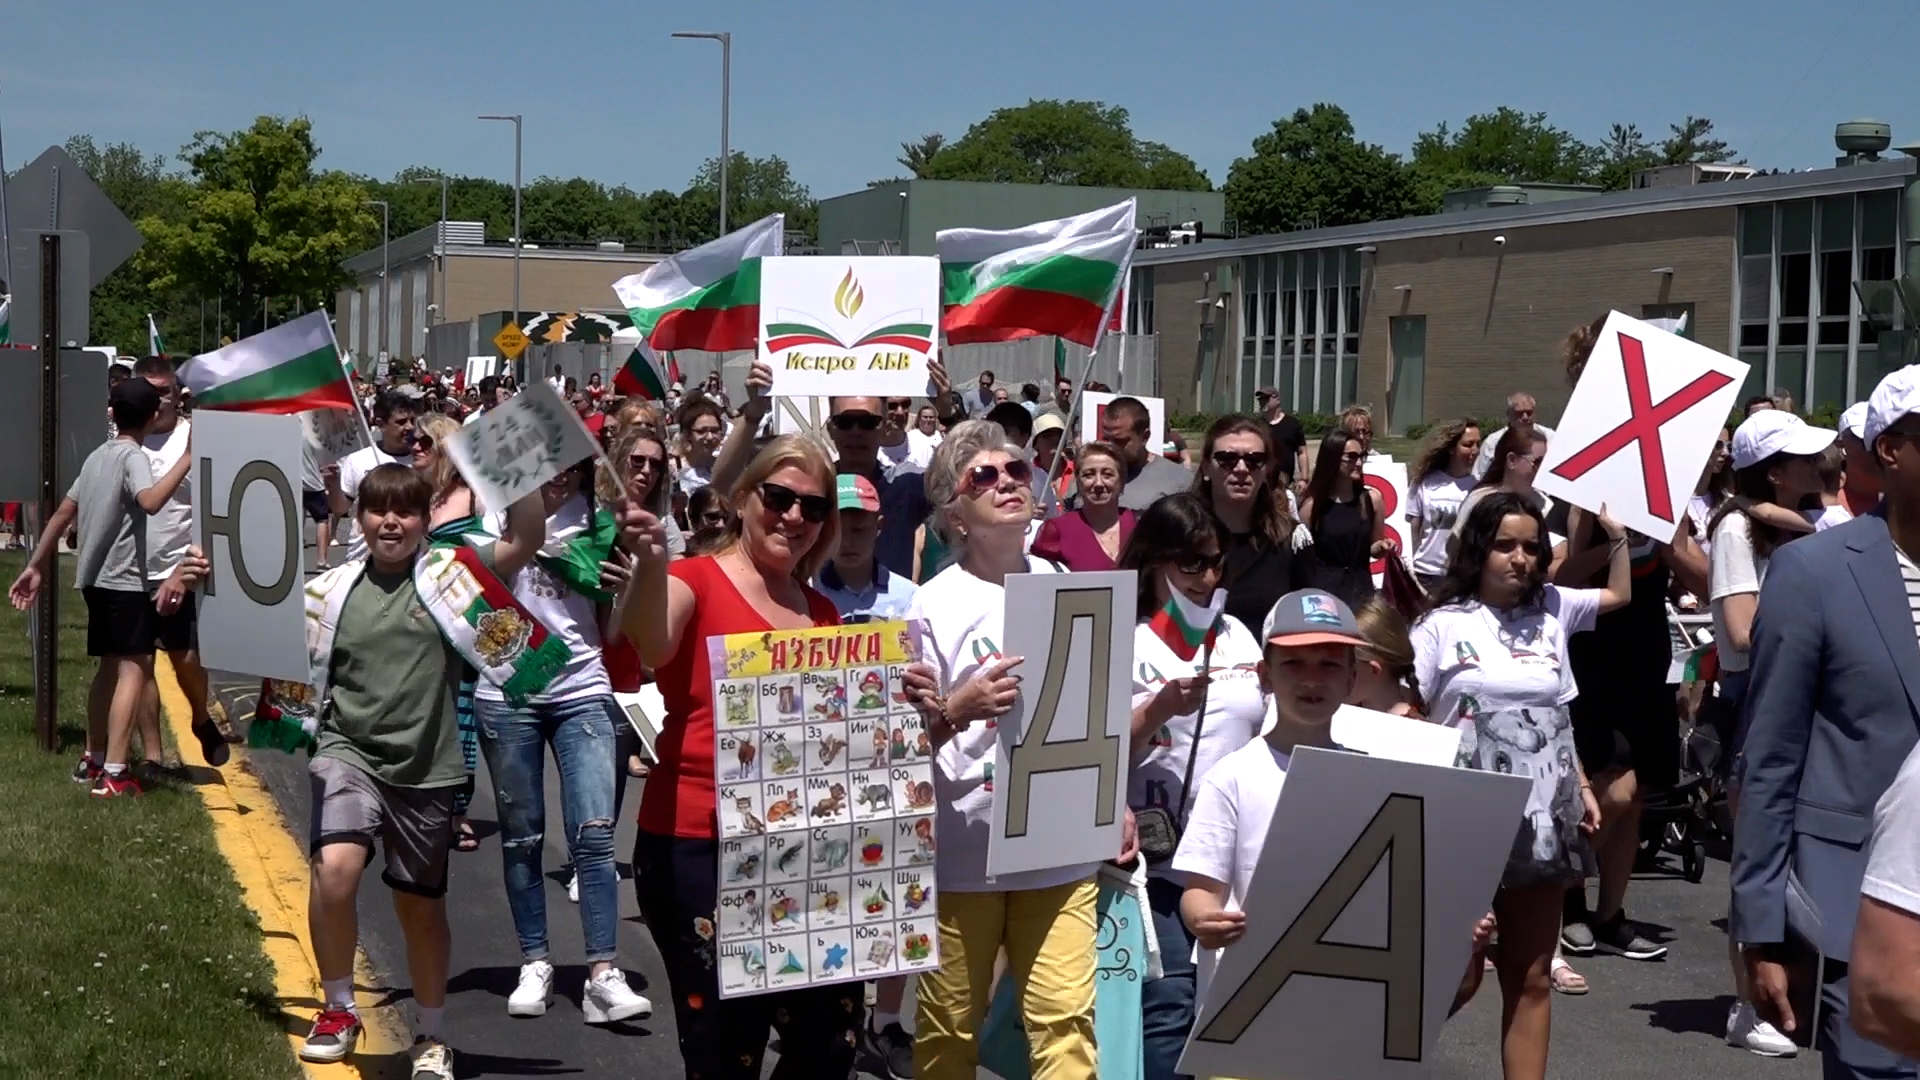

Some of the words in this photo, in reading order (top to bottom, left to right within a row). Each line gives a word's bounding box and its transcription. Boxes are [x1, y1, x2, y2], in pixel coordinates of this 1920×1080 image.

[786, 351, 857, 374] Искра
[868, 352, 911, 371] АБВ
[200, 457, 299, 607] Ю
[770, 632, 882, 670] АЗБУКА
[804, 672, 818, 684] Вв
[850, 670, 861, 683] Гг
[719, 683, 736, 695] Аа
[762, 682, 777, 696] Бб
[1005, 587, 1120, 839] Д
[851, 721, 868, 734] Ии
[901, 716, 918, 730] Йй
[763, 730, 786, 743] Жж
[808, 726, 822, 738] Зз
[720, 738, 736, 750] Ее
[853, 772, 869, 784] Нн
[892, 768, 908, 781] Оо
[766, 783, 783, 796] Лл
[808, 777, 829, 790] Мм
[721, 787, 736, 799] Кк
[813, 829, 828, 841] Сс
[857, 826, 870, 838] Тт
[899, 822, 913, 836] Уу
[724, 841, 741, 853] Пп
[769, 837, 784, 850] Рр
[857, 878, 872, 889] Чч
[897, 872, 920, 885] Шш
[769, 887, 785, 900] Хх
[810, 881, 827, 894] Цц
[722, 893, 744, 909] Фф
[856, 926, 879, 939] Юю
[900, 922, 914, 934] Яя
[1196, 792, 1424, 1062] А
[721, 944, 746, 958] Щщ
